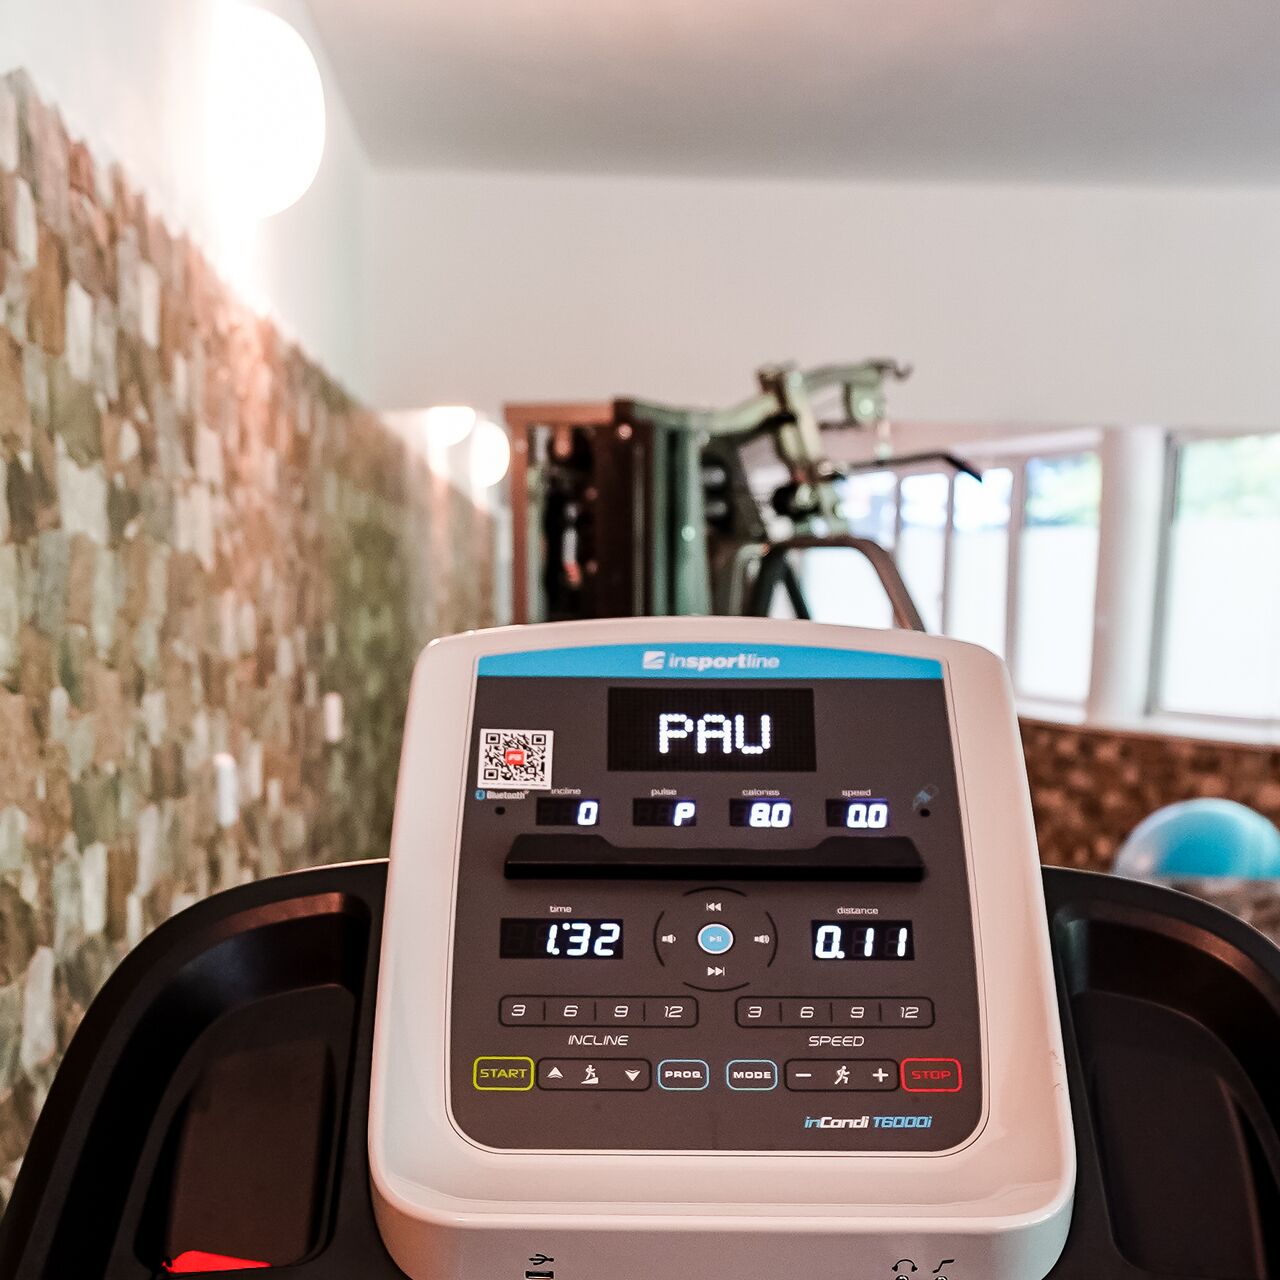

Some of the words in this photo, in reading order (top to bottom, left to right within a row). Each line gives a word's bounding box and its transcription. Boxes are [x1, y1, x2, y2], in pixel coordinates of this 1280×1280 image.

[669, 653, 780, 672] insportline
[659, 713, 771, 755] PAU
[651, 788, 677, 796] pulse
[742, 788, 780, 796] calories
[842, 789, 872, 797] speed
[577, 801, 599, 826] 0
[549, 904, 572, 913] time
[837, 906, 879, 915] distance
[511, 1004, 527, 1017] 3
[563, 1005, 579, 1018] 6
[614, 1005, 629, 1018] 9
[664, 1006, 684, 1019] 12
[747, 1006, 763, 1019] 3
[800, 1006, 815, 1019] 6
[850, 1006, 865, 1019] 9
[900, 1006, 920, 1019] 12
[567, 1034, 630, 1047] INCLINE
[808, 1035, 866, 1047] SPEED
[479, 1068, 528, 1079] START
[732, 1070, 772, 1079] MODE
[911, 1070, 952, 1080] STOP
[804, 1115, 870, 1129] inCondi
[872, 1115, 934, 1129] T6000i
